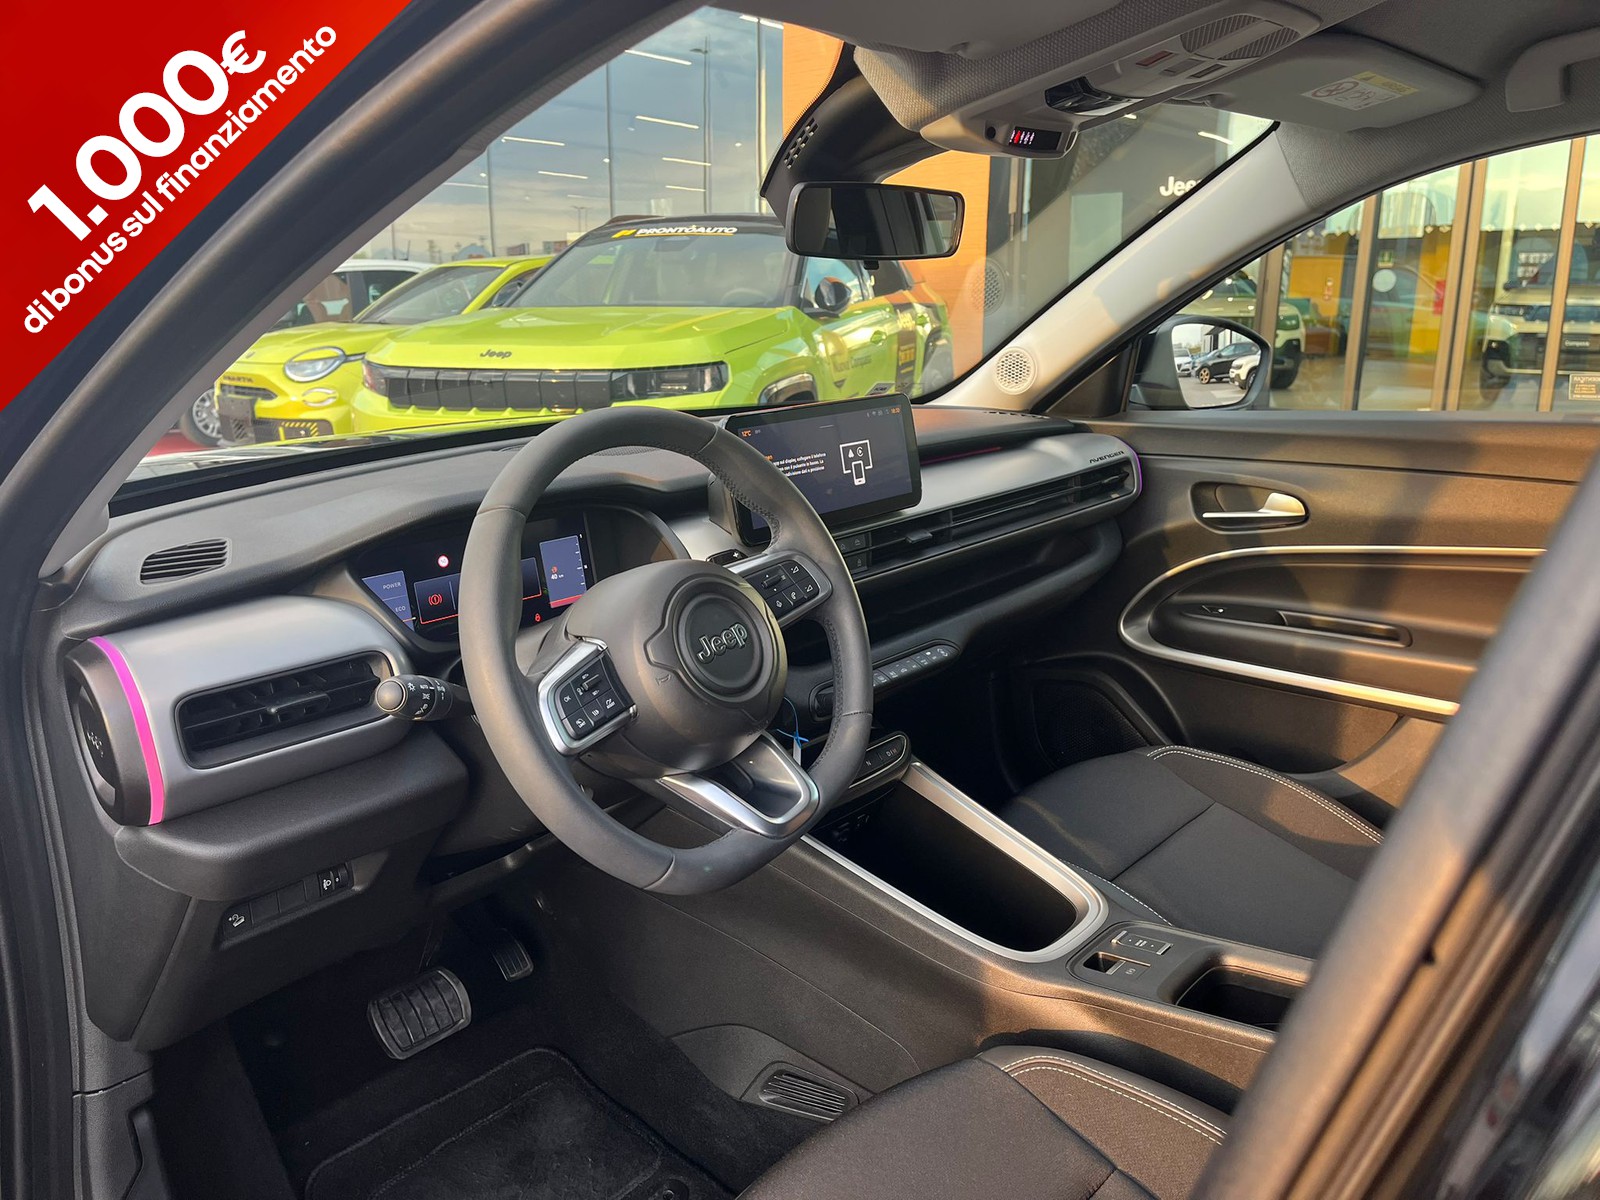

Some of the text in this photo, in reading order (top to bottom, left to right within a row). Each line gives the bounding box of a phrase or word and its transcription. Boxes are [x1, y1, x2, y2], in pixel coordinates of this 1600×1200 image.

[480, 349, 512, 359] Jeep
[382, 581, 402, 590] POWER
[395, 605, 406, 613] ECO
[697, 622, 749, 661] Jeep
